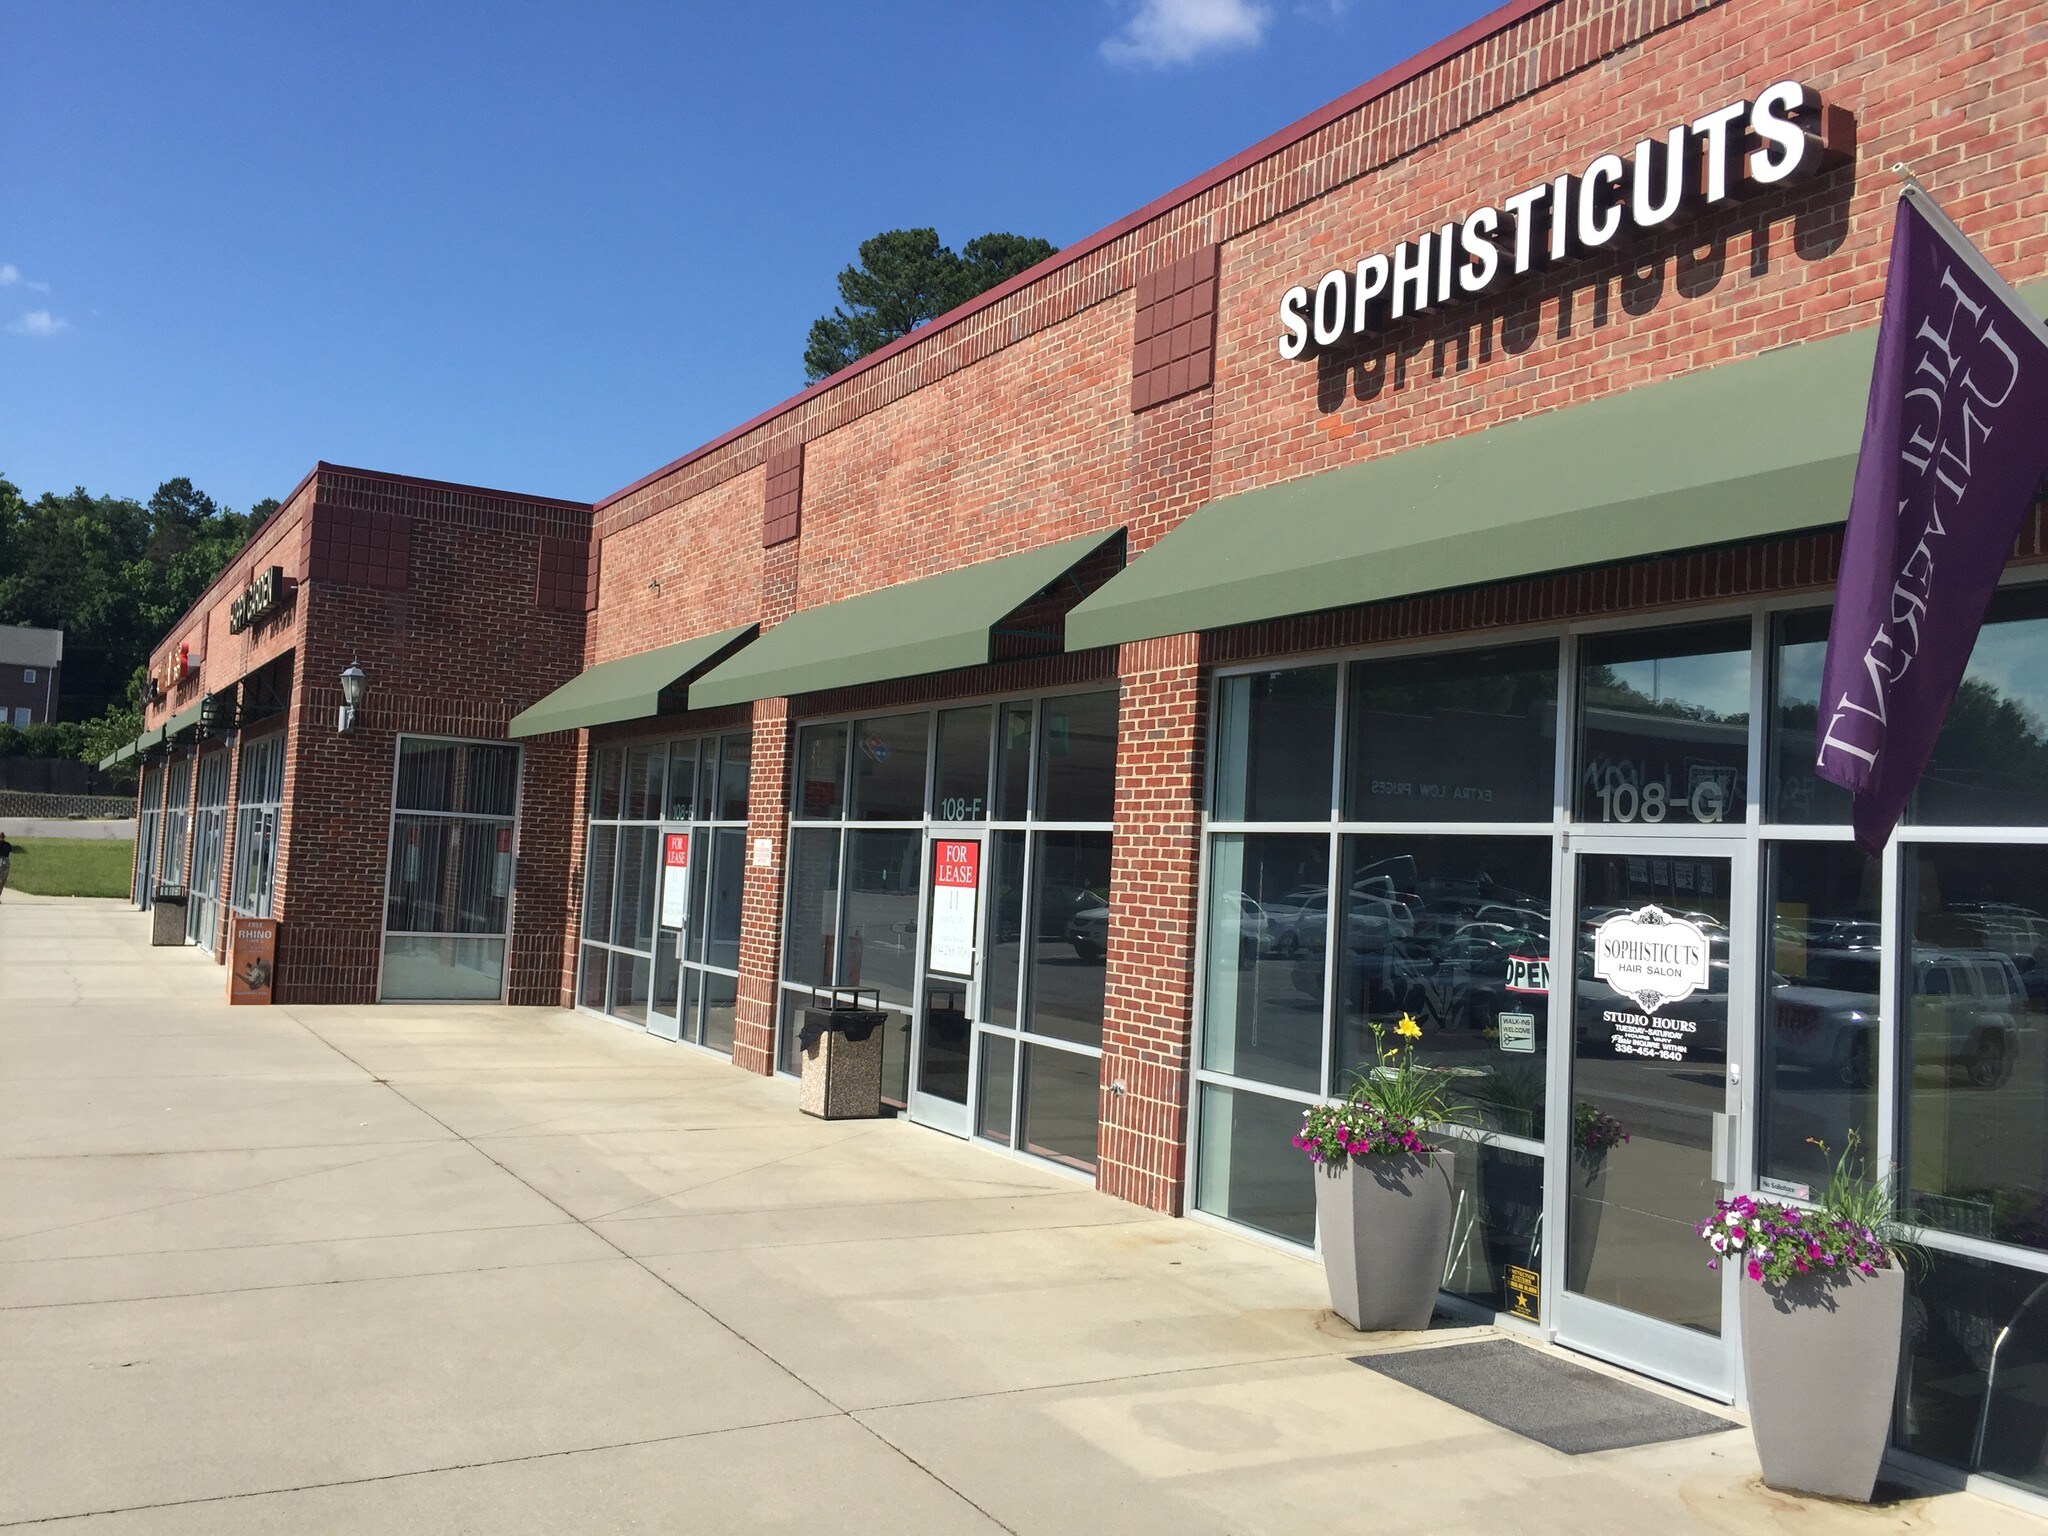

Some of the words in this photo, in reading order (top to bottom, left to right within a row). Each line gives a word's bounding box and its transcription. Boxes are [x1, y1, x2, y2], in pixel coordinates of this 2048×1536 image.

[1279, 79, 1805, 360] SOPHISTICUTS
[941, 797, 981, 820] 108-F
[1596, 781, 1723, 823] 108-G
[672, 837, 683, 849] FOR
[667, 851, 686, 864] LEASE
[946, 845, 967, 862] FOR
[939, 865, 973, 883] LEASE
[238, 930, 272, 939] RHINO
[1604, 939, 1699, 966] SOPHISTICUTS
[1504, 958, 1549, 988] OPEN
[1619, 963, 1642, 973] HAIR
[1646, 966, 1682, 977] SALON
[1503, 1018, 1530, 1026] WALK-INS
[1603, 1010, 1649, 1026] STUDIO
[1652, 1016, 1697, 1033] HOURS
[1503, 1026, 1531, 1034] WELCOME
[1615, 1024, 1683, 1040] TUESDAY-SATURDAY
[1624, 1032, 1650, 1041] HOURS
[1653, 1036, 1672, 1044] VARY
[1615, 1043, 1683, 1061] 336-454-1640
[1632, 1039, 1660, 1049] INQUIRE
[1662, 1043, 1687, 1053] WITHIN
[1771, 1182, 1795, 1193] Solicitors
